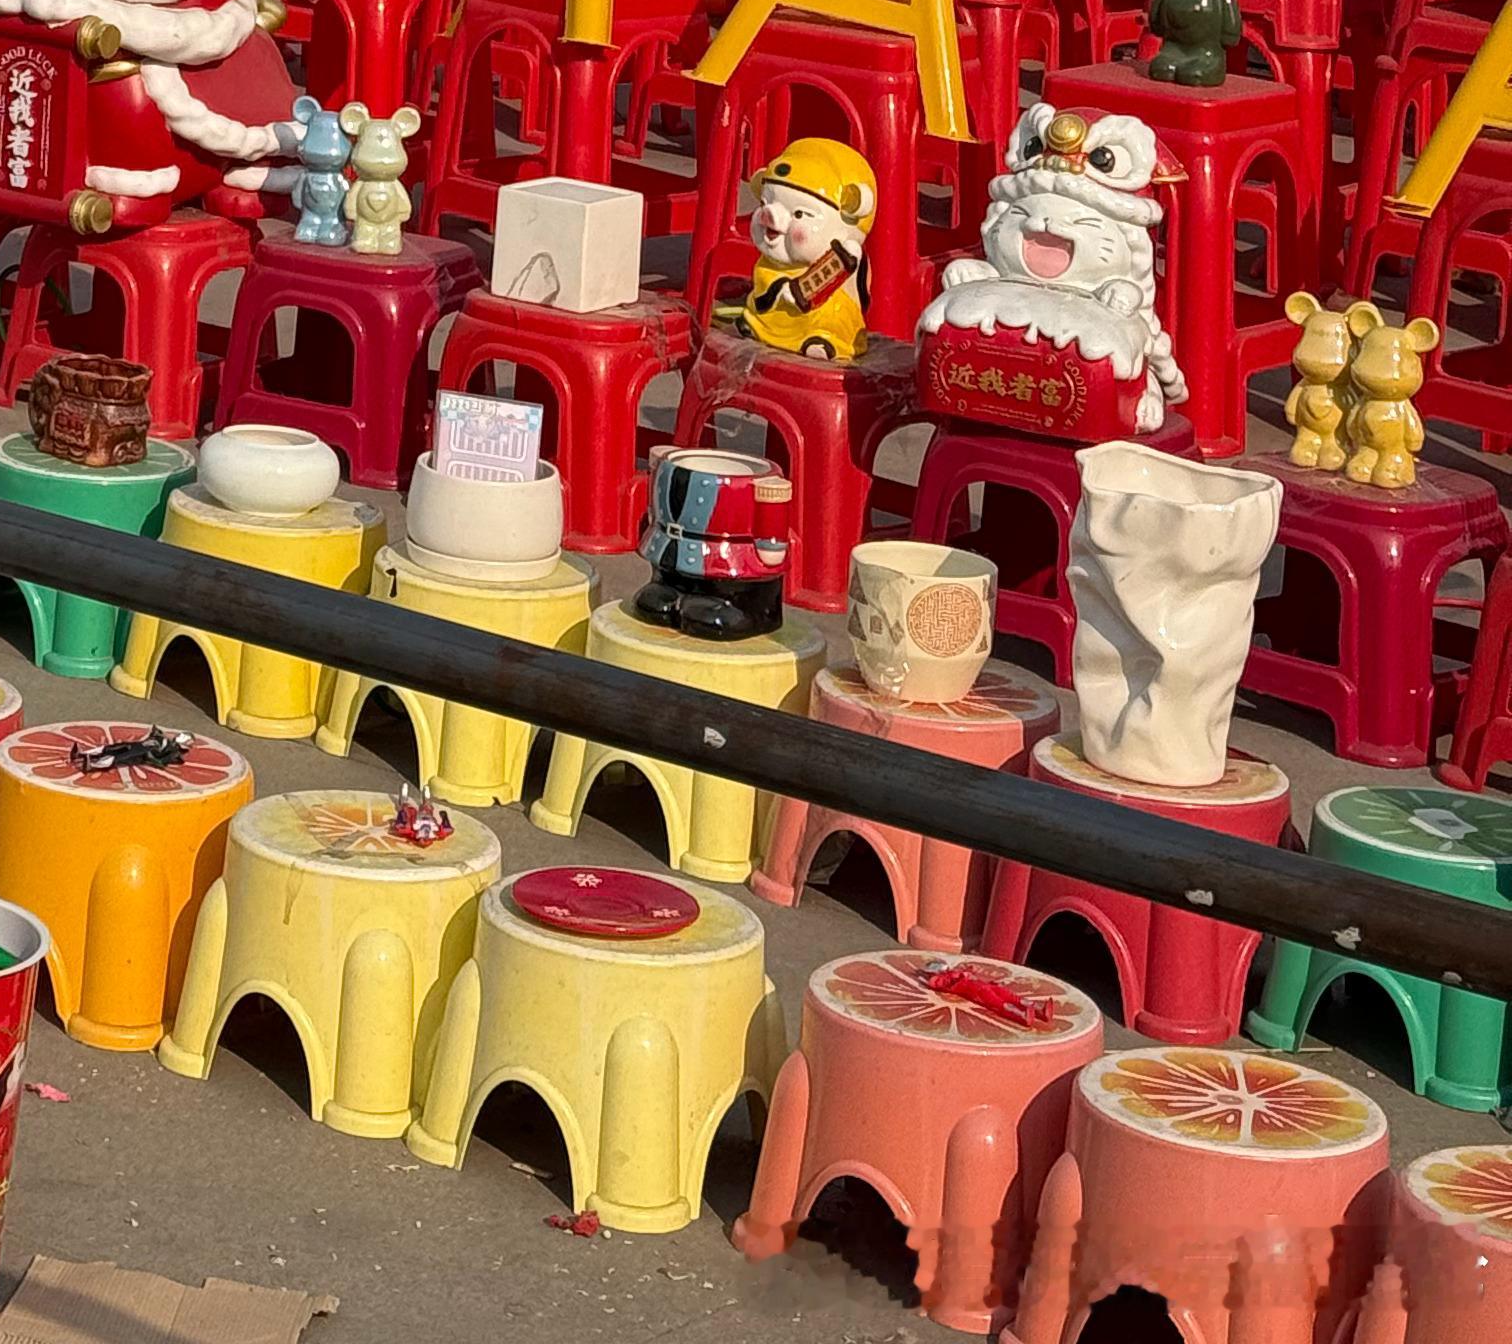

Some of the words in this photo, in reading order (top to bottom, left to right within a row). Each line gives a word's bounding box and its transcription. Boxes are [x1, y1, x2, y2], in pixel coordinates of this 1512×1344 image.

[28, 48, 59, 81] LUCK
[4, 68, 39, 189] 近我者富
[948, 362, 1067, 408] 近我者富
